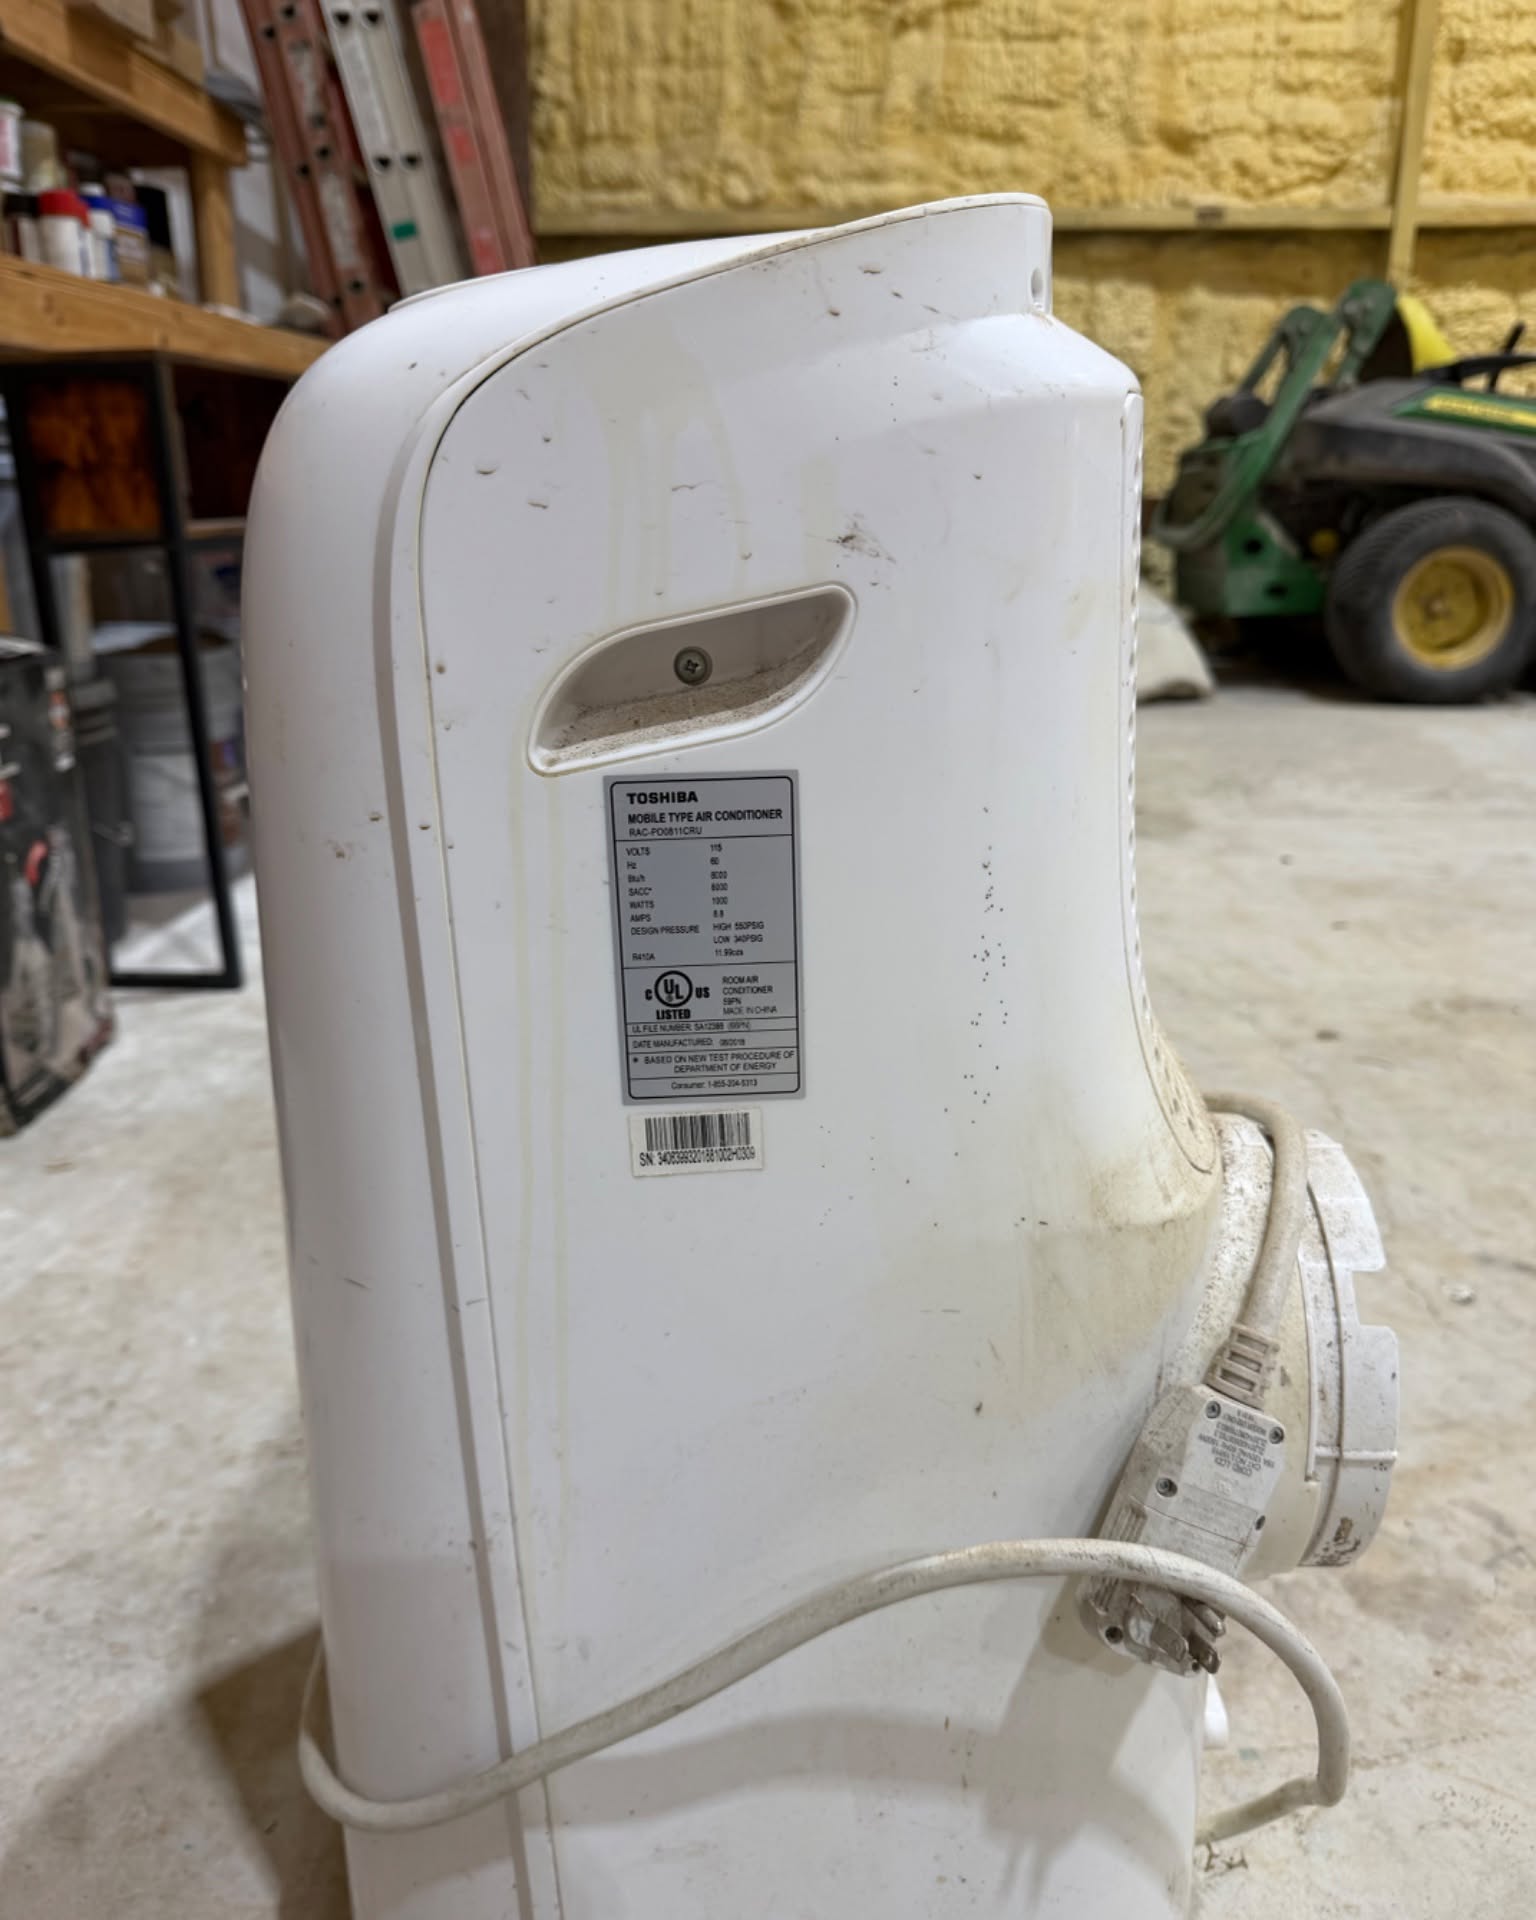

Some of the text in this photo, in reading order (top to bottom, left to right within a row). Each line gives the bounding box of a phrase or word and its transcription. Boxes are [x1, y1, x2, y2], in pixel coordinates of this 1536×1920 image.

[626, 791, 698, 804] TOSHIBA
[628, 809, 783, 824] MOBILE TYPE AIR CONDITIONER
[625, 844, 722, 856] VOLTS 115
[710, 856, 720, 865] 60
[630, 900, 654, 909] WATTS
[630, 914, 651, 922] AMPS
[631, 927, 659, 935] DESIGN
[660, 925, 700, 934] PRESSURE
[712, 922, 732, 931] HIGH
[713, 936, 730, 944] LOW
[722, 976, 745, 984] ROOM
[695, 987, 710, 998] US
[723, 986, 773, 995] CONDITIONER
[656, 1008, 690, 1020] LISTED
[723, 1006, 778, 1015] MADE IN CHINA
[632, 1026, 642, 1034] UL
[643, 1025, 658, 1033] FILE
[632, 1040, 651, 1048] DATE
[644, 1056, 672, 1064] BASED
[688, 1055, 706, 1063] NEW
[709, 1054, 728, 1062] TEST
[731, 1052, 781, 1061] PROCEDURE
[674, 1064, 728, 1073] DEPARTMENT
[743, 1063, 776, 1071] ENERGY
